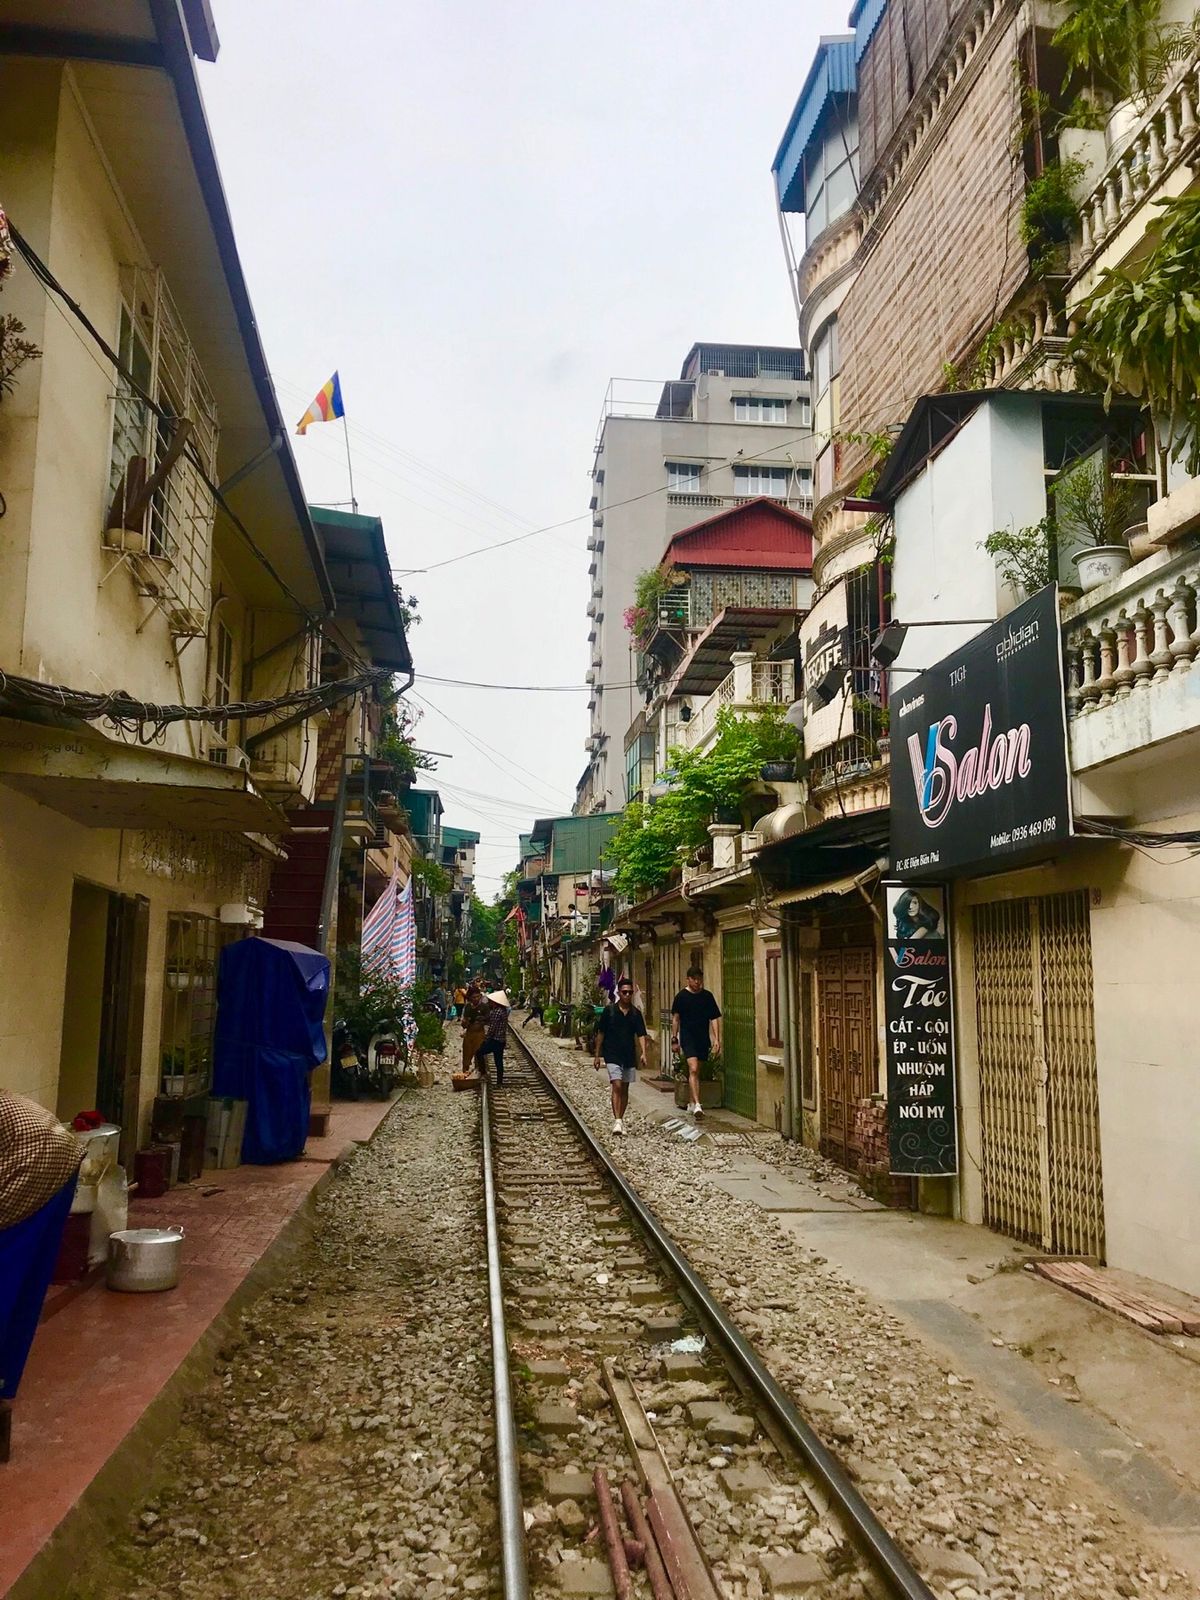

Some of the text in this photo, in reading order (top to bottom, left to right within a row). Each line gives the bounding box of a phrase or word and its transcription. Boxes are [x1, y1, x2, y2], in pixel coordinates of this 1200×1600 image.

[996, 620, 1039, 656] obsidian
[949, 664, 966, 687] TIGI
[899, 694, 925, 718] davines
[990, 815, 1056, 849] Mobile: 0936 469 098
[891, 974, 948, 1009] Tóc
[889, 1015, 914, 1033] CẮT
[924, 1018, 949, 1037] GỘI
[893, 1038, 907, 1054] ÉP
[909, 1079, 935, 1097] HẤP
[899, 1101, 945, 1119] NỐI MY
